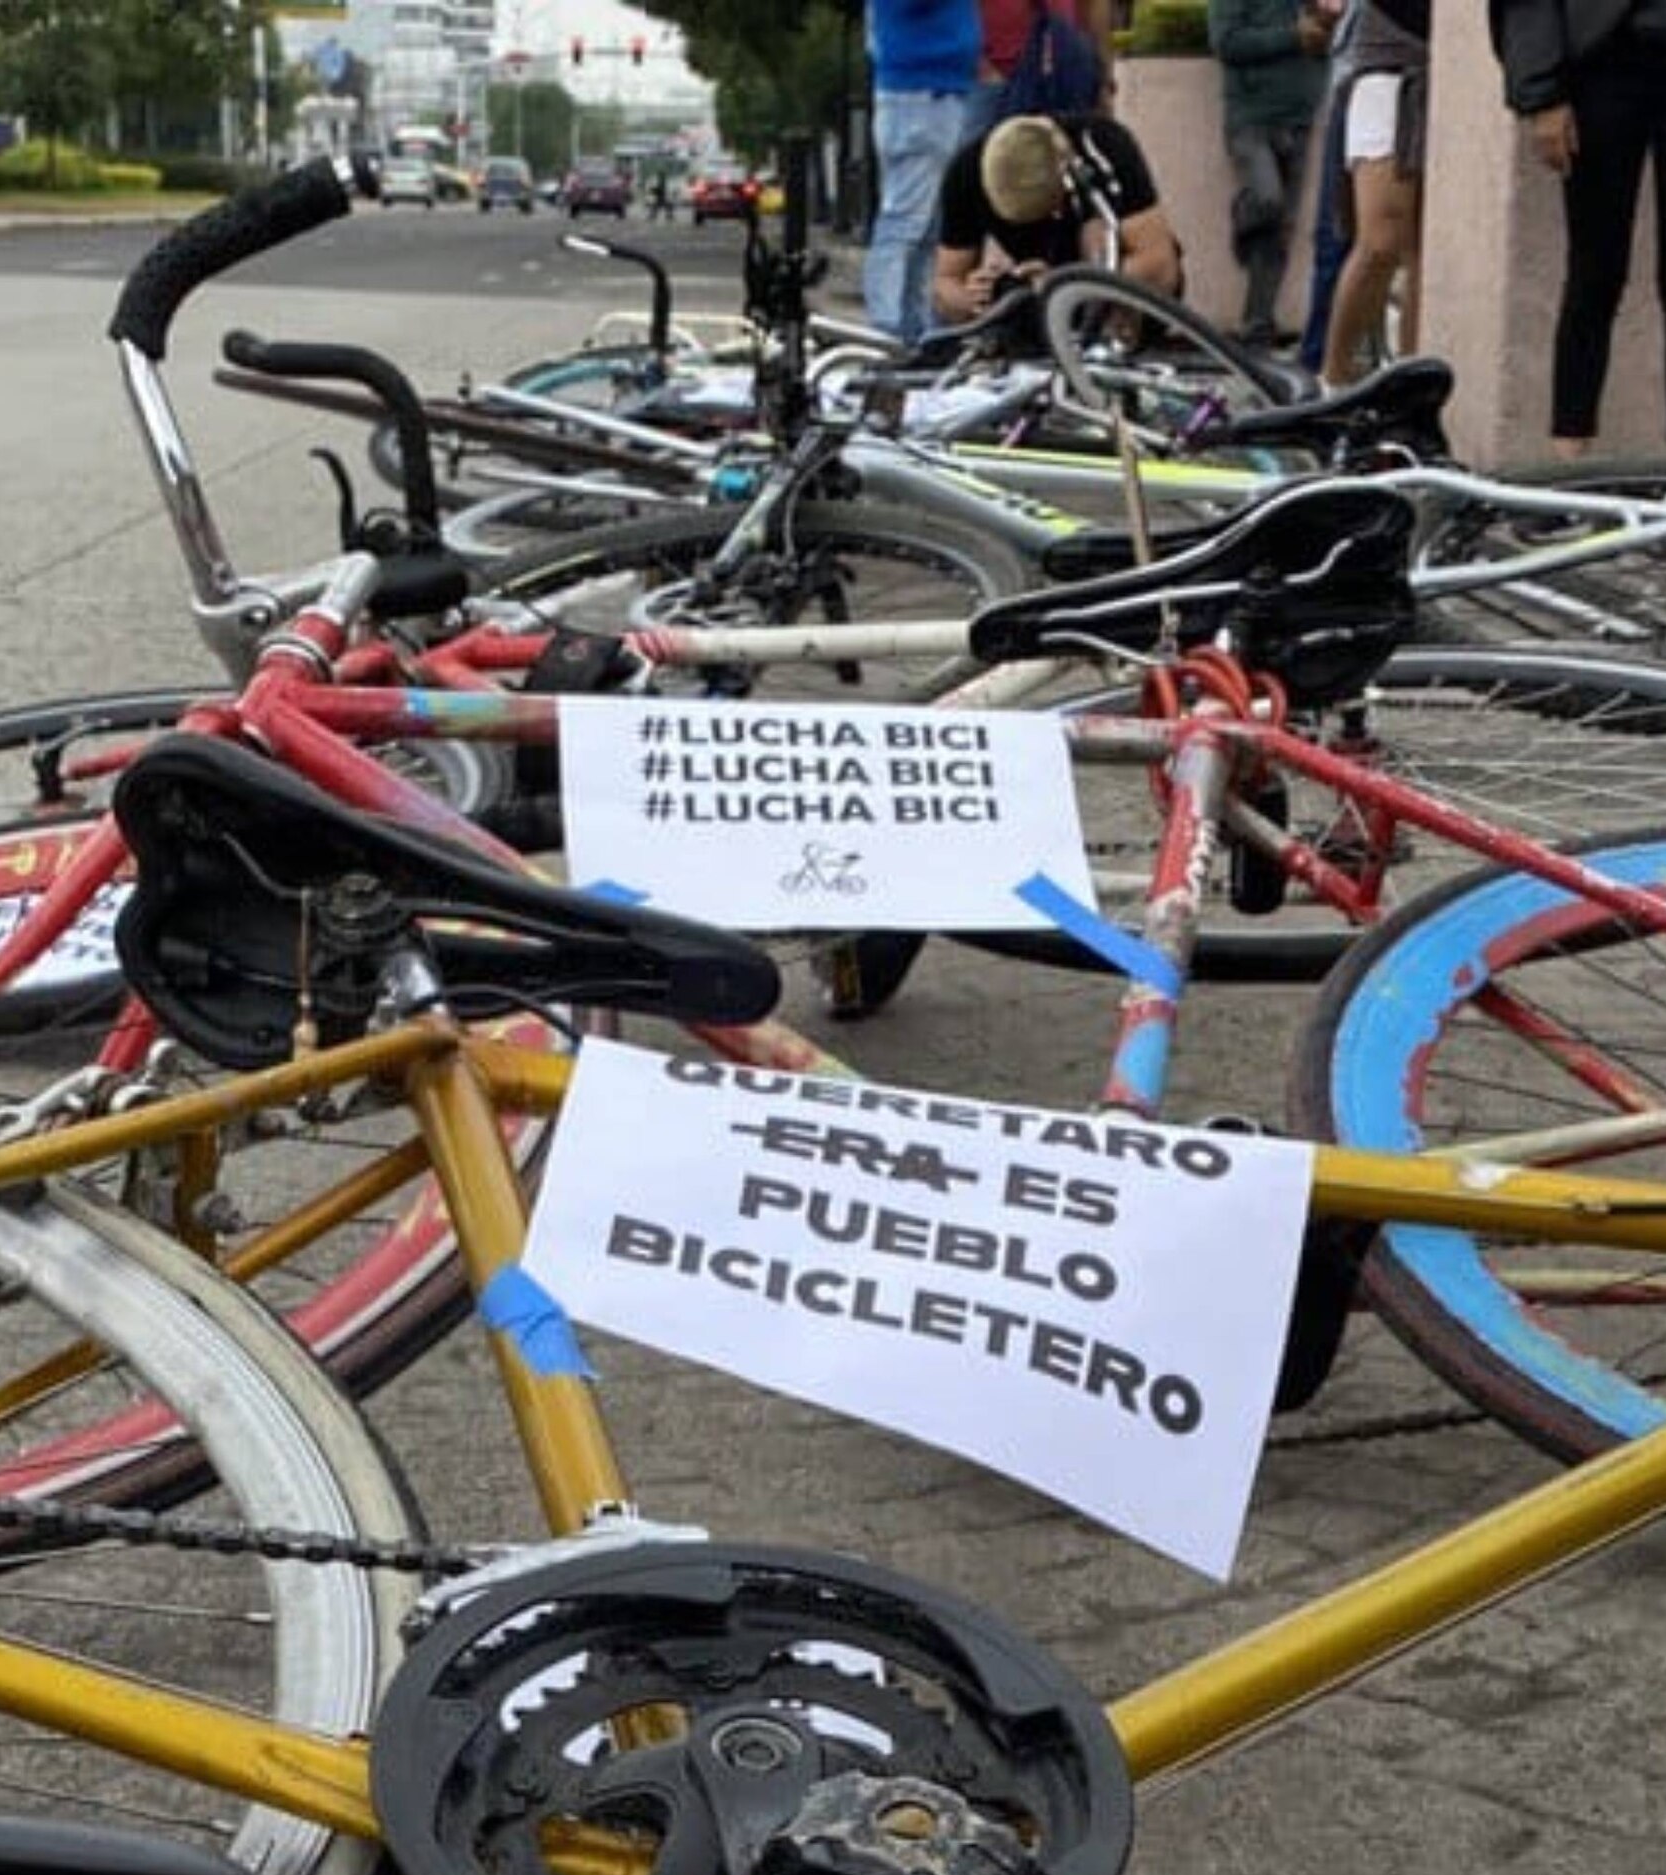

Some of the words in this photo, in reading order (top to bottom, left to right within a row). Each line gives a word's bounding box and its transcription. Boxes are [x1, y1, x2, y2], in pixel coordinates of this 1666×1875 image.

[637, 715, 868, 748] #LUCHA
[883, 722, 989, 751] BICI
[642, 751, 872, 786] #LUCHA
[889, 758, 995, 788] BICI
[645, 792, 876, 823] #LUCHA
[893, 795, 1000, 824] BICI
[1002, 1162, 1119, 1227] ES
[737, 1174, 1119, 1303] PUEBLO
[605, 1214, 1204, 1436] BICICLETERO
